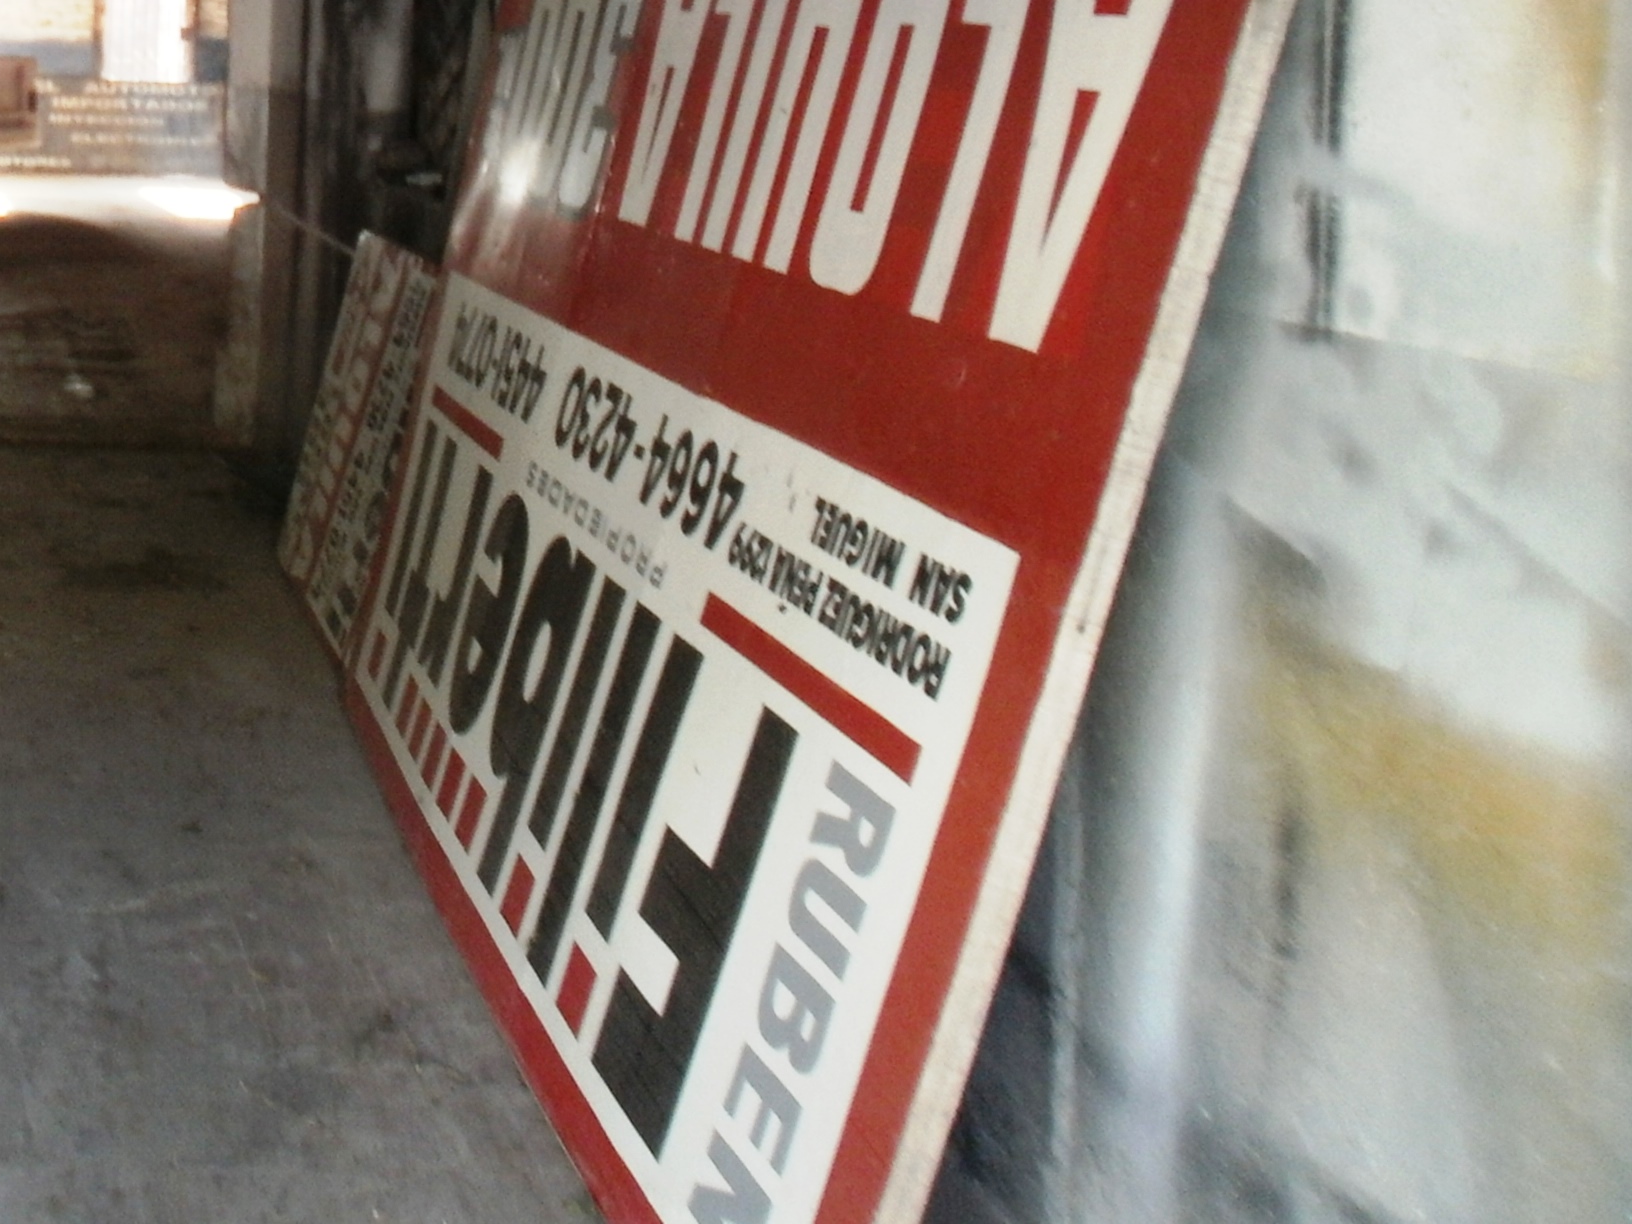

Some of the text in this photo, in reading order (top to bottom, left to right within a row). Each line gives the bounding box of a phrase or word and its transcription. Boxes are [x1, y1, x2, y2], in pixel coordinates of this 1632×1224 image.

[526, 461, 666, 590] PROPIEDADES
[555, 366, 745, 550] 4664-4230
[729, 521, 951, 702] RODRIGUEZ PEÑA 1299
[809, 497, 973, 625] SAN MIGUEL
[687, 760, 897, 1223] RUBEN
